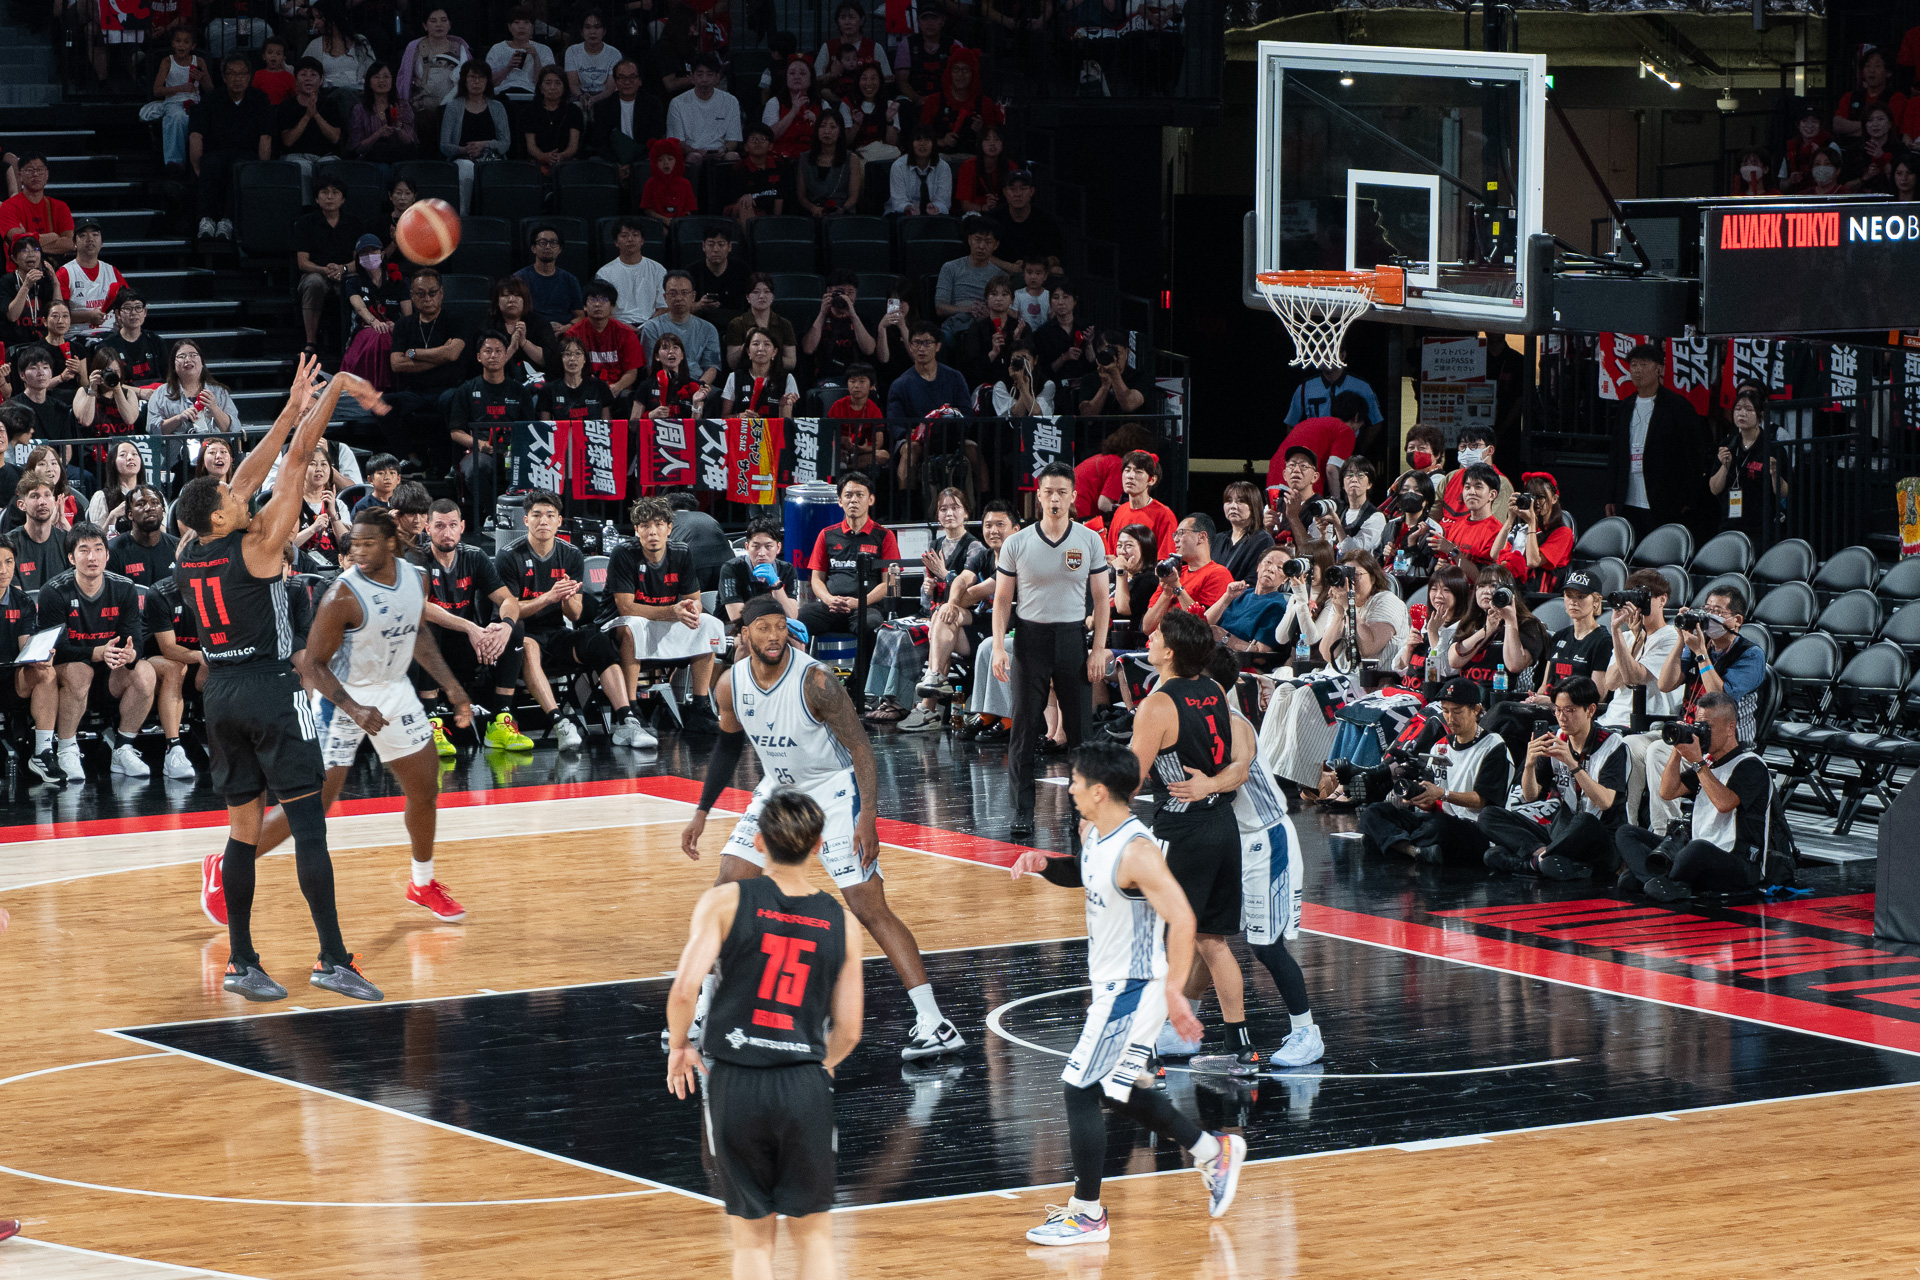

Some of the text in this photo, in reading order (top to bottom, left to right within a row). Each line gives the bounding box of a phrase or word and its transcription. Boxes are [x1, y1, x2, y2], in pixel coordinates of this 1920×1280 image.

[1721, 214, 1782, 249] ALVARK
[1785, 212, 1839, 248] TOKYO
[1672, 338, 1690, 393] STE
[1732, 339, 1751, 389] STE
[527, 420, 563, 495] ス海
[656, 419, 691, 476] 周人
[699, 419, 728, 490] ス海
[739, 434, 747, 452] SAIZ
[1032, 415, 1062, 478] 颯太
[736, 459, 750, 496] サイズ
[751, 473, 773, 491] 11
[181, 561, 197, 569] LAND
[830, 558, 857, 568] Panas
[190, 576, 231, 628] 11
[210, 632, 229, 645] SAIZ
[750, 734, 798, 748] VELCA
[774, 767, 796, 785] 25
[756, 908, 831, 931] HARRIER
[757, 932, 817, 1007] 75
